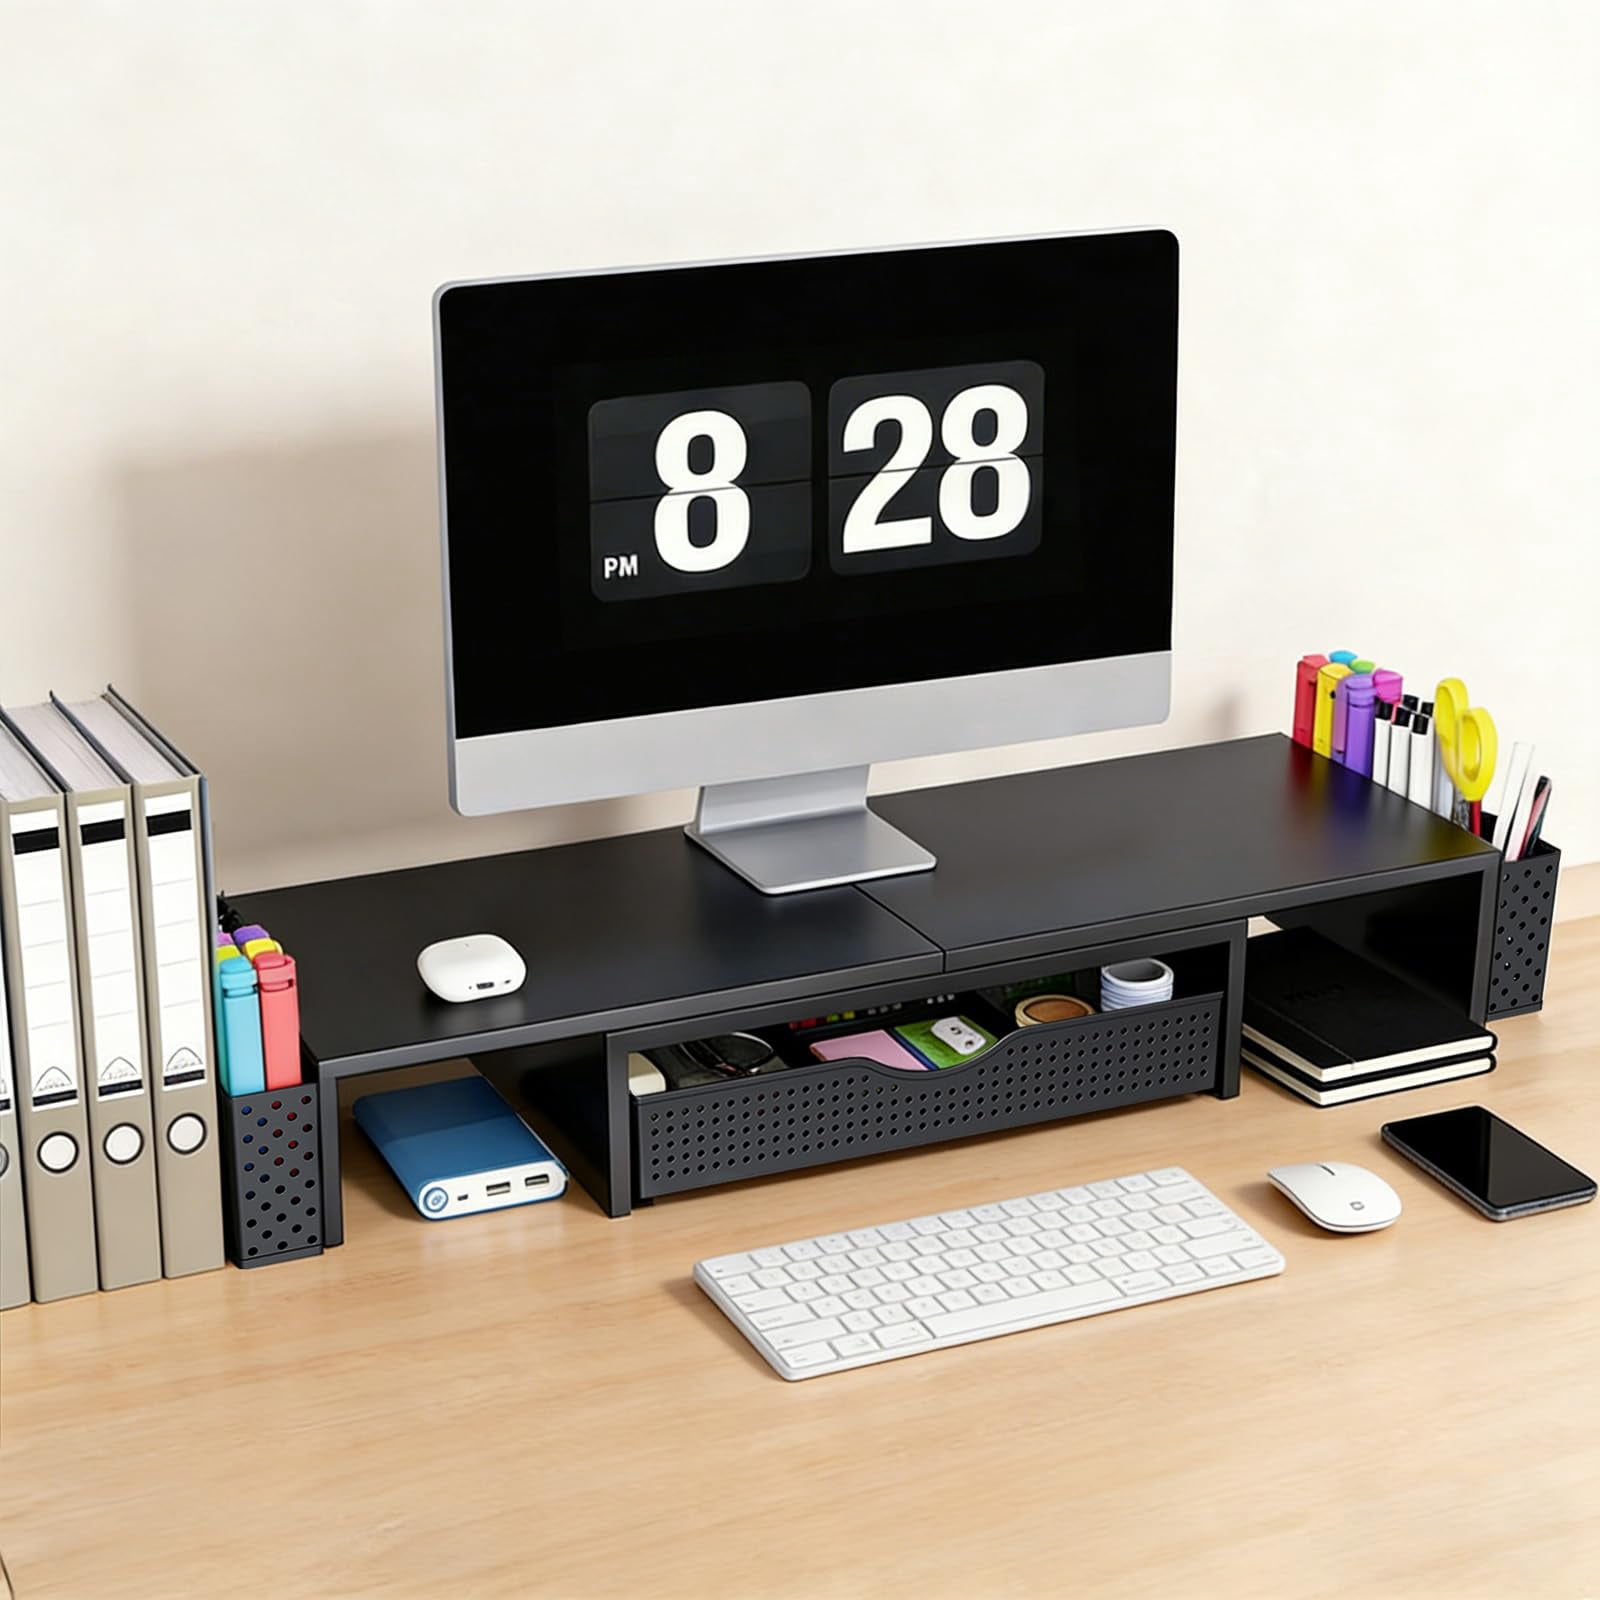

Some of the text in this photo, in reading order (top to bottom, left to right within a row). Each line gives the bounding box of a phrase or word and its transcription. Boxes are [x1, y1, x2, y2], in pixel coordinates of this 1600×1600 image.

[654, 384, 1031, 572] 8 28
[604, 554, 638, 579] PM
